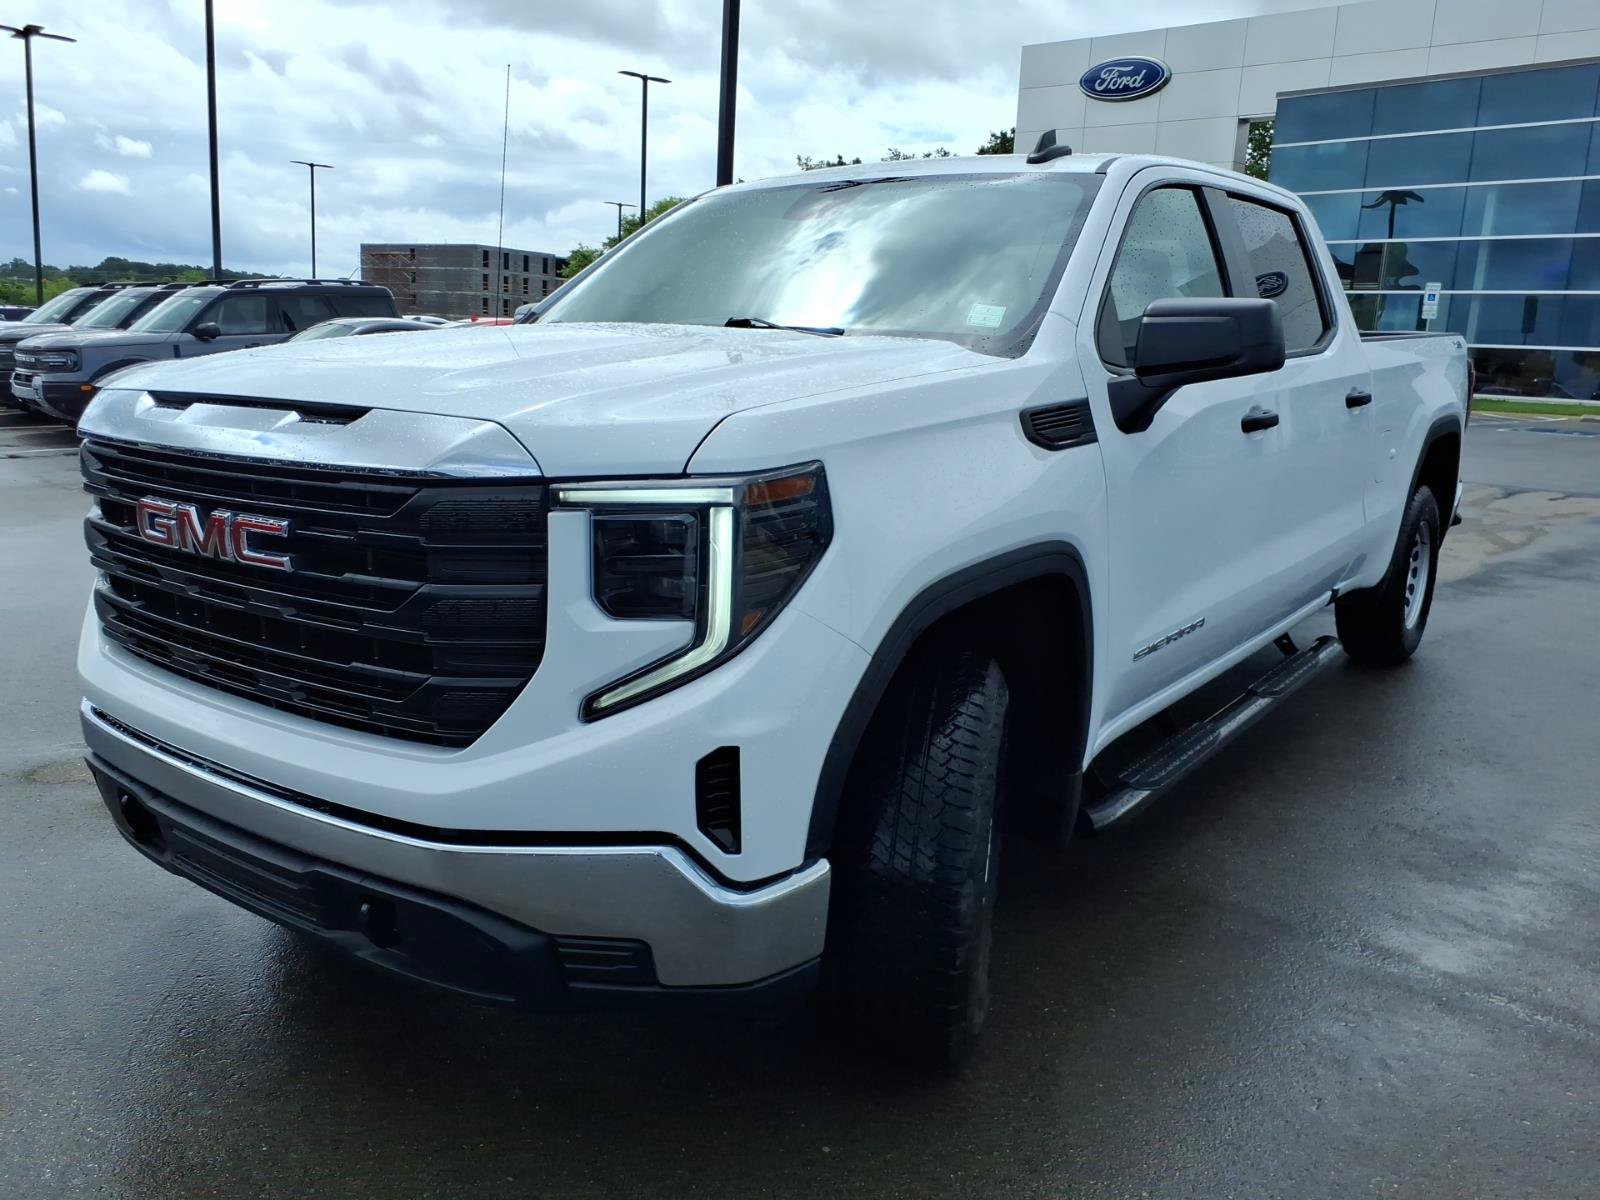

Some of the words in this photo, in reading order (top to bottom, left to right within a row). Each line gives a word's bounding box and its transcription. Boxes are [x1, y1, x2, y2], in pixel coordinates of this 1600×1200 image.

[1095, 66, 1146, 91] Ford
[136, 495, 294, 573] GMC
[1133, 617, 1205, 661] SIERRA
